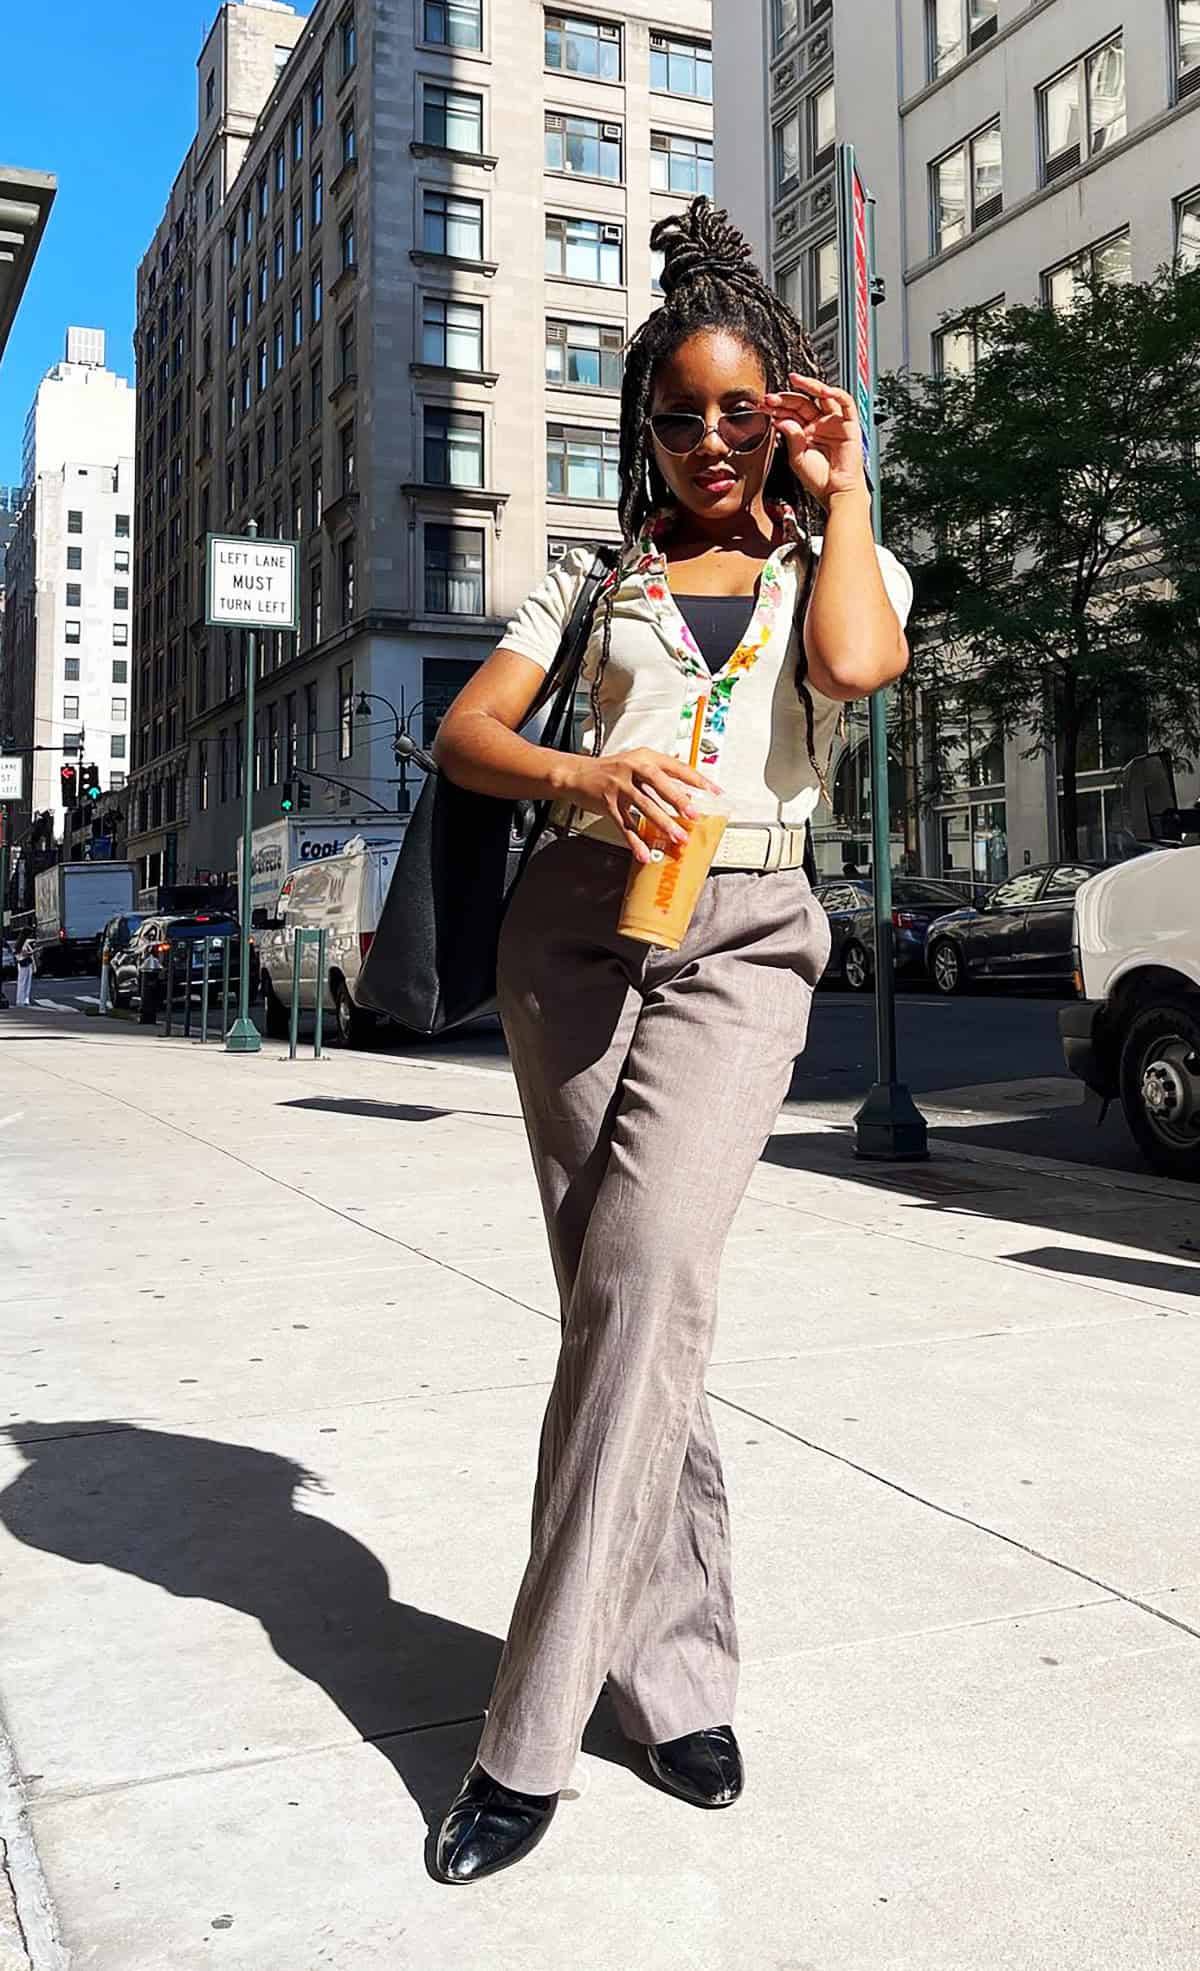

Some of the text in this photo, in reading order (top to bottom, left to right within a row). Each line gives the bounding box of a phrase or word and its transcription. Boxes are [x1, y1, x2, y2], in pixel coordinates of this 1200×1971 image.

[220, 551, 287, 568] LEFT LANE
[233, 574, 272, 592] MUST
[220, 597, 287, 614] TURN LEFT
